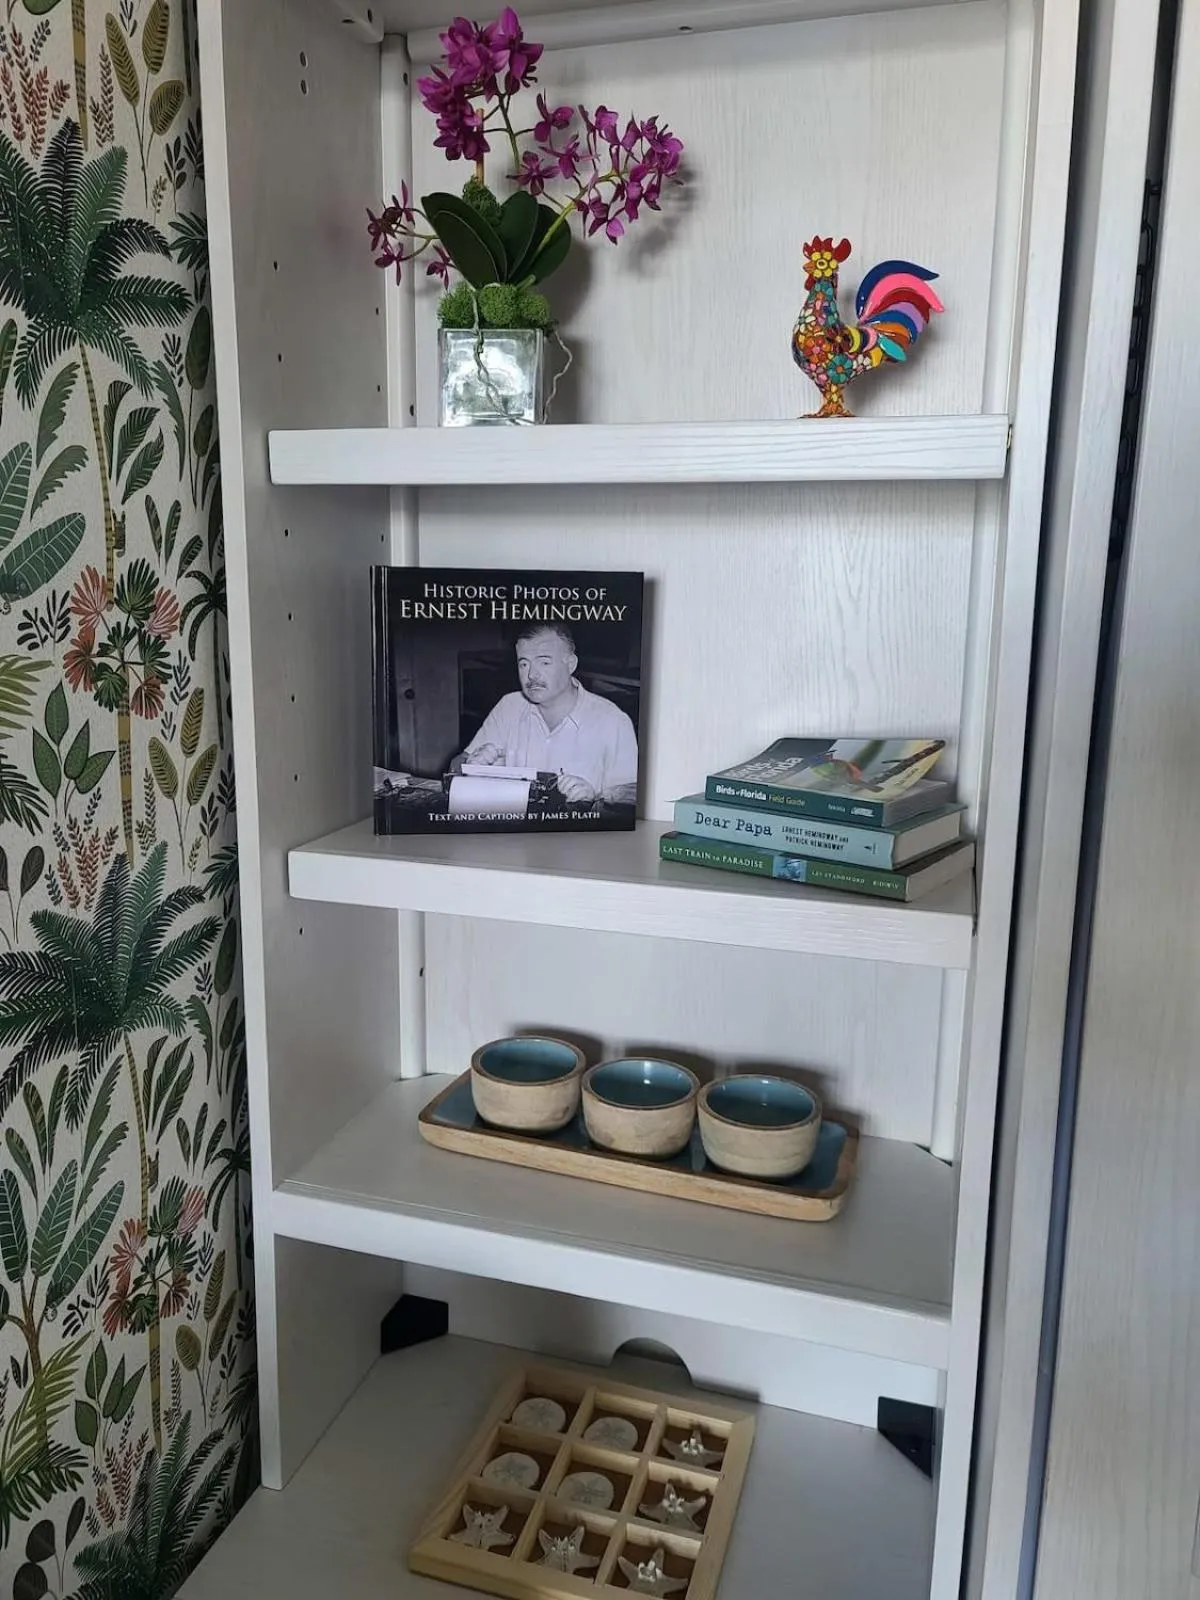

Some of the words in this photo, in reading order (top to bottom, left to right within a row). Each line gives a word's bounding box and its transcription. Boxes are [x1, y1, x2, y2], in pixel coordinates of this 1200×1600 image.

[424, 583, 507, 600] HISTORIC
[514, 584, 579, 601] PHOTOS
[585, 588, 607, 601] OF
[401, 599, 482, 620] ERNEST
[491, 601, 628, 621] HEMINGWAY
[716, 784, 736, 796] Birds
[740, 788, 767, 801] Florida
[428, 812, 451, 821] TEXT
[454, 813, 475, 821] AND
[478, 812, 525, 821] CAPTIONS
[528, 812, 539, 820] BY
[541, 811, 569, 821] JAMES
[572, 810, 600, 819] PLATH
[694, 811, 730, 829] Dear
[735, 818, 772, 837] Papa
[663, 845, 683, 856] LAST
[685, 848, 711, 860] TRAIN
[722, 855, 765, 869] PARADISE
